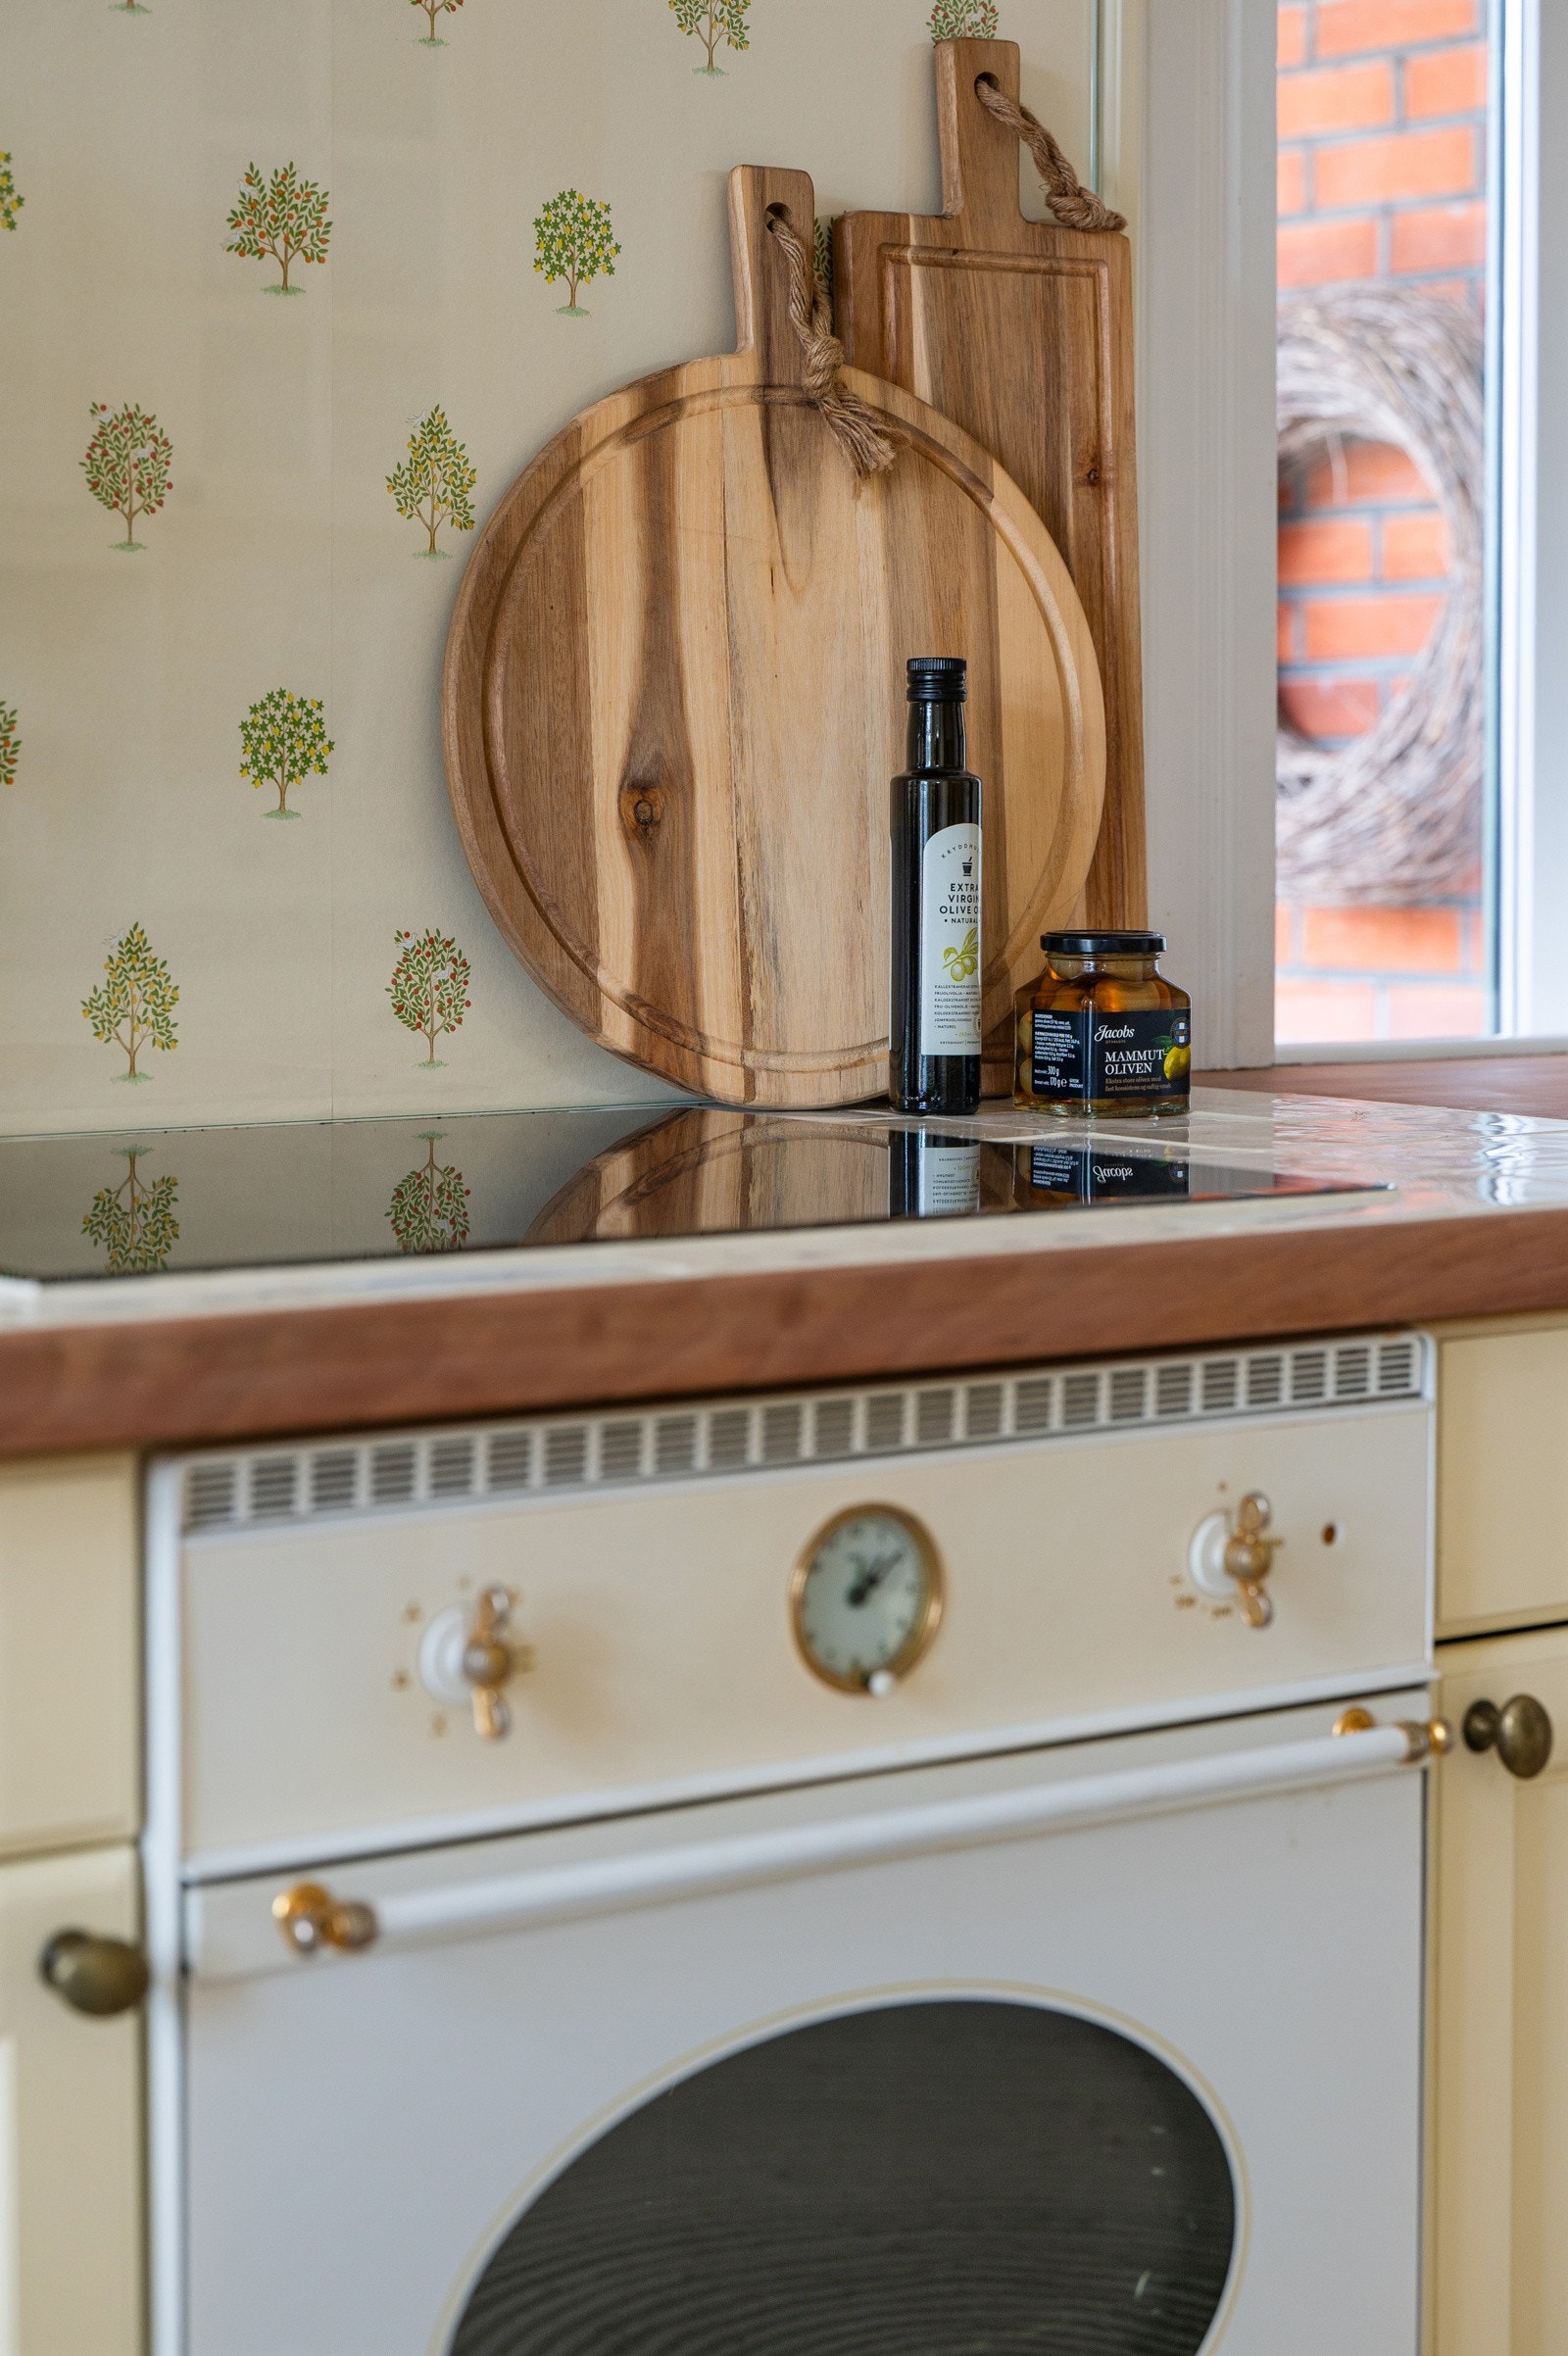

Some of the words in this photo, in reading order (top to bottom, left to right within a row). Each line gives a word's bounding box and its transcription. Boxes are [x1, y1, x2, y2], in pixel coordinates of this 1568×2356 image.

[939, 906, 972, 914] OLIVE
[1094, 1024, 1135, 1042] Jacobs
[1104, 1061, 1152, 1075] OLIVEN
